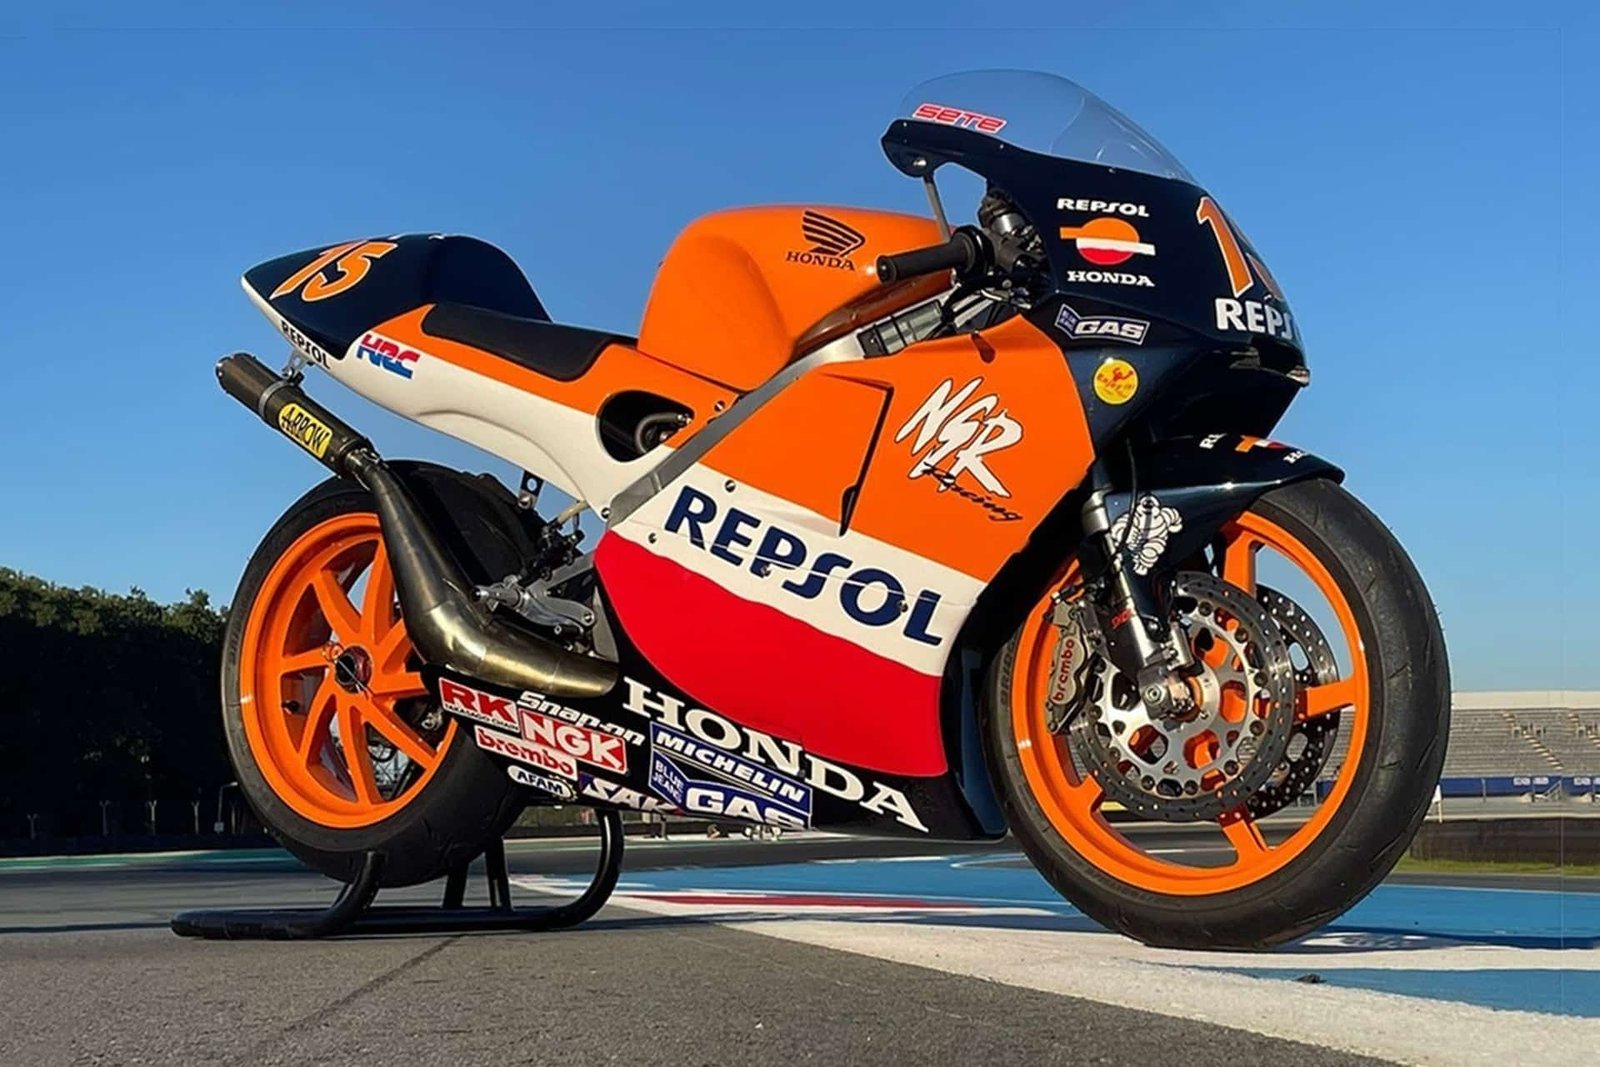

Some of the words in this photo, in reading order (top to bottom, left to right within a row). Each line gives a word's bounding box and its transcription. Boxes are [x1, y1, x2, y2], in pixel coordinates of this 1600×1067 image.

[1057, 197, 1150, 218] REPSOL
[269, 240, 398, 301] 15
[786, 251, 856, 271] HONDA
[1067, 270, 1156, 288] HONDA
[1074, 321, 1145, 339] GAS
[1215, 297, 1301, 340] REPS
[281, 320, 331, 370] REPSOL
[281, 406, 330, 457] ARROW
[664, 485, 943, 647] REPSOL
[1052, 639, 1075, 701] brembo
[441, 679, 517, 725] RK
[516, 691, 646, 746] Snap-on
[477, 729, 574, 776] brembo
[522, 711, 623, 771] NGK
[622, 676, 930, 834] HONDA
[517, 769, 563, 796] AFAM
[655, 760, 684, 790] BLUE
[656, 731, 806, 803] MICHELIN
